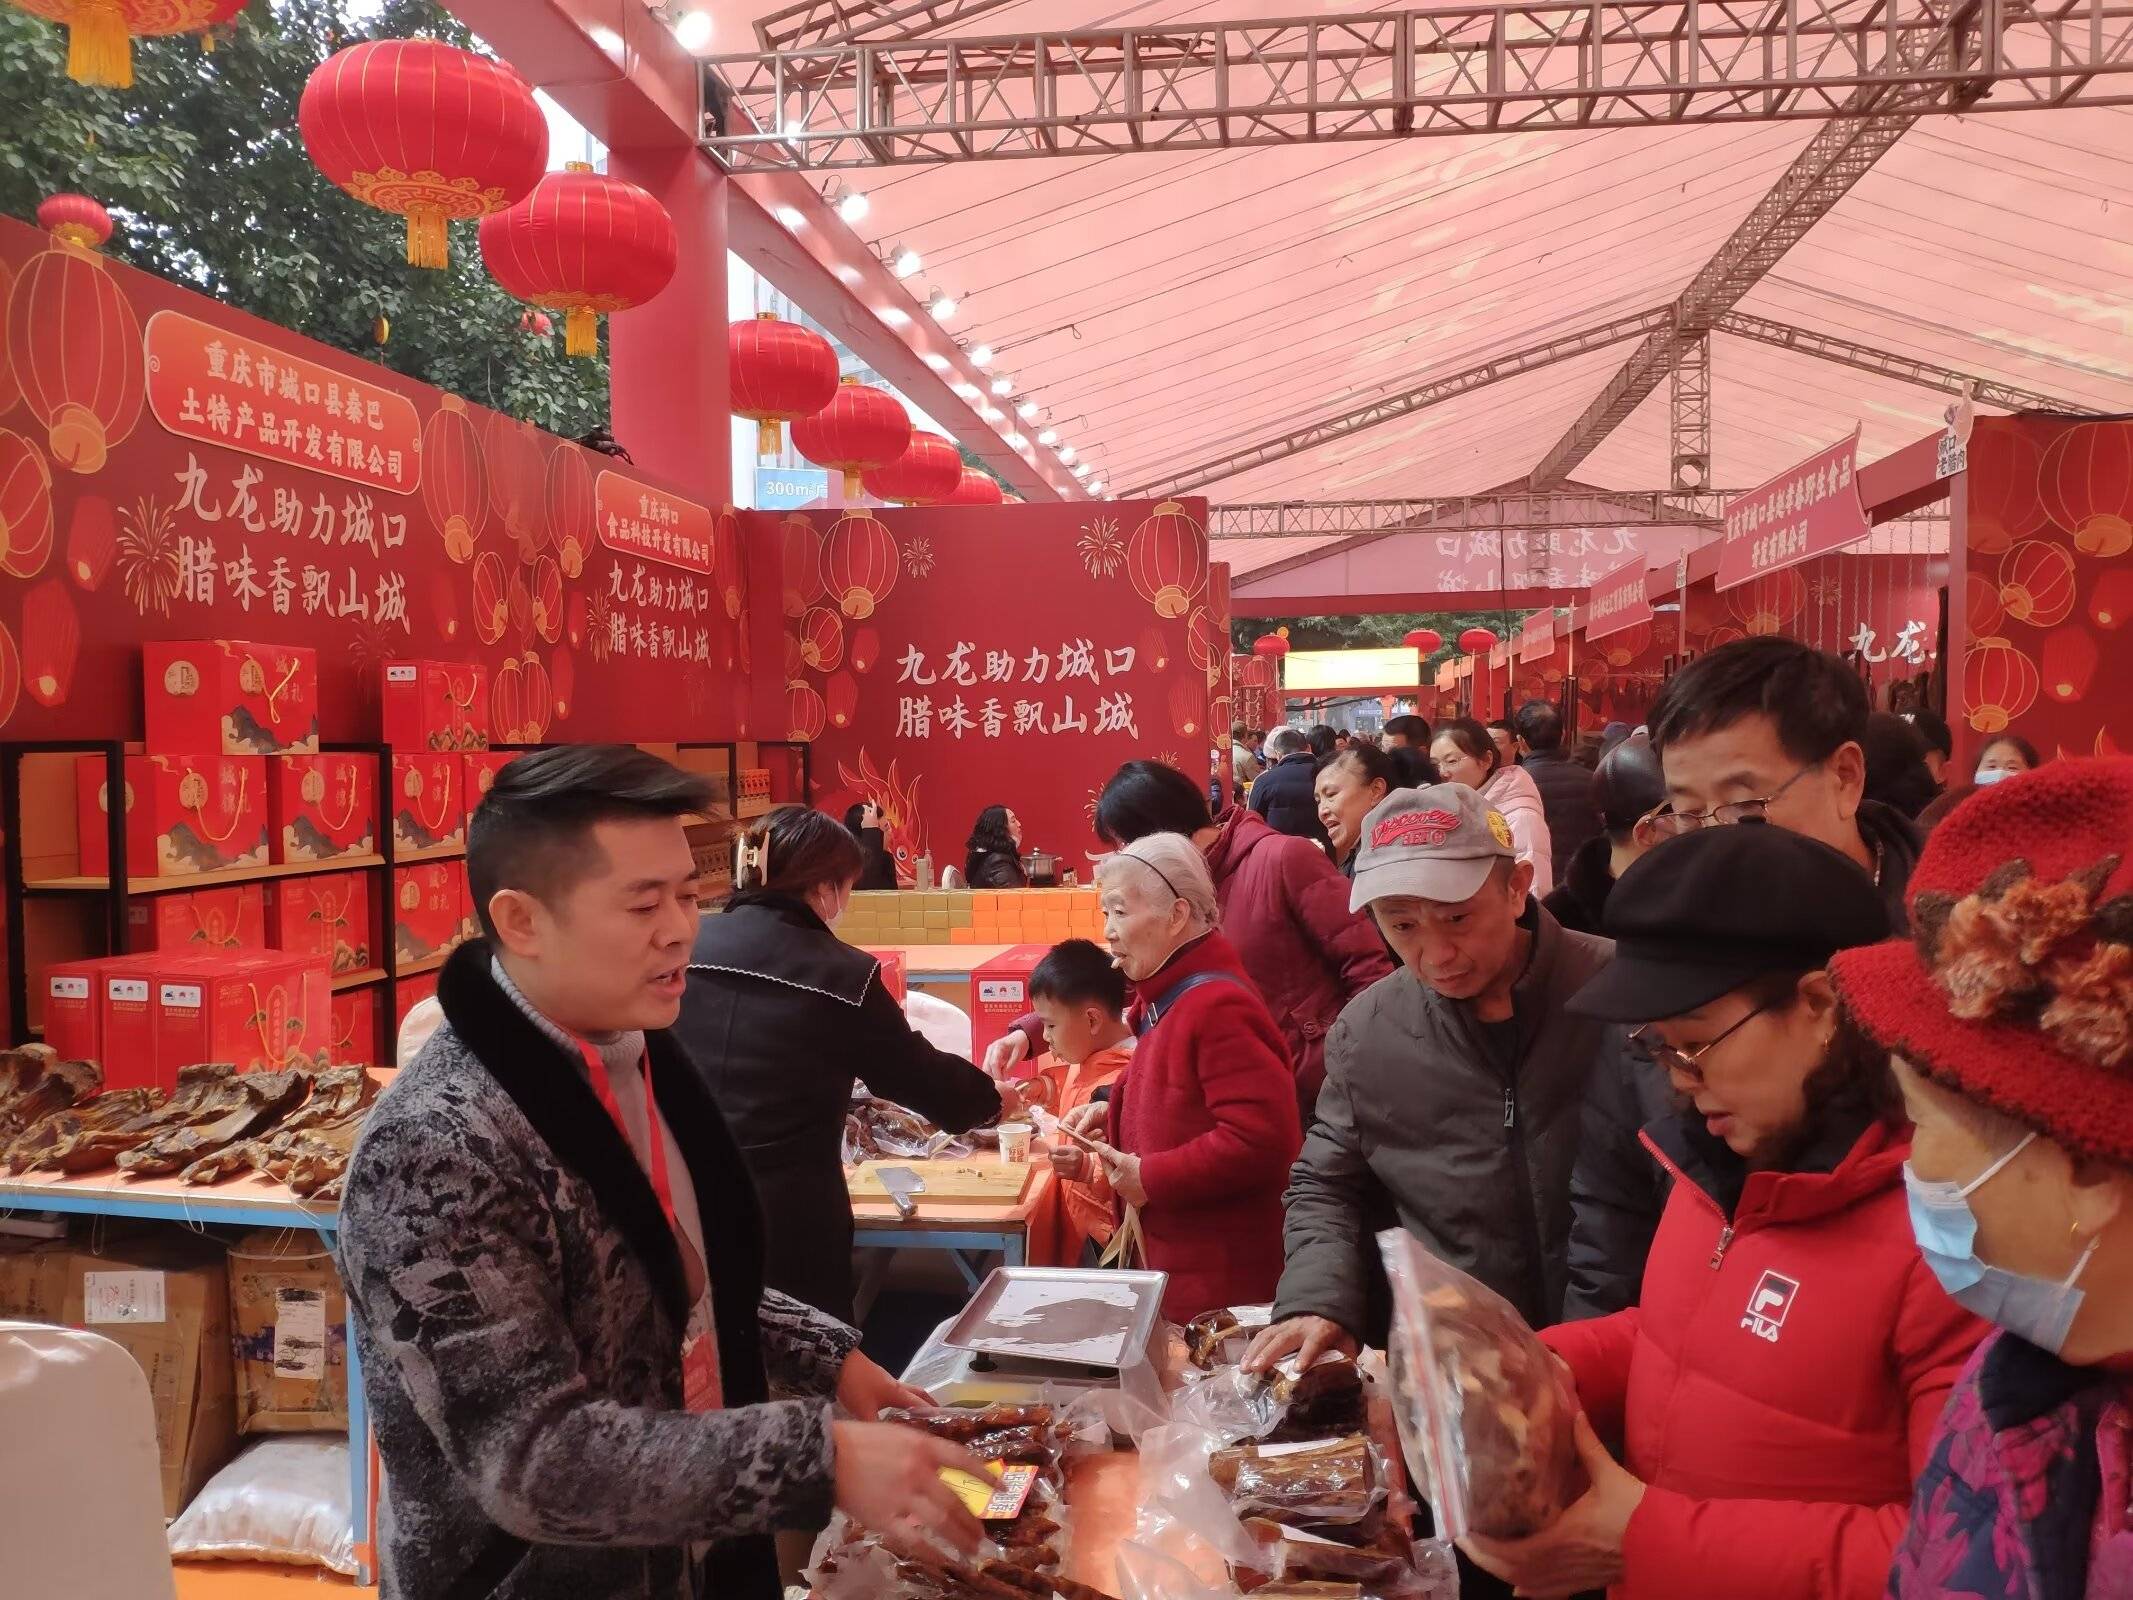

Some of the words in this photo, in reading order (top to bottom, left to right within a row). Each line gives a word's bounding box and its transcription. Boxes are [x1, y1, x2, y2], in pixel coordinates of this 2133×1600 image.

[204, 341, 384, 431] 重庆市城口县秦巴
[179, 388, 402, 483] 土特产品开发有限公司
[174, 452, 406, 558] 九龙助力城口
[607, 511, 709, 566] 食品科技开发有限公司
[173, 536, 410, 634] 腊味香飘山城
[608, 559, 709, 619] 九龙助力城口
[609, 611, 712, 670] 腊味香飘山城
[896, 638, 1136, 686] 九龙助力城口
[1847, 620, 1938, 663] 九龙
[896, 692, 1138, 740] 腊味香飘山城
[1741, 1317, 1779, 1343] FILA
